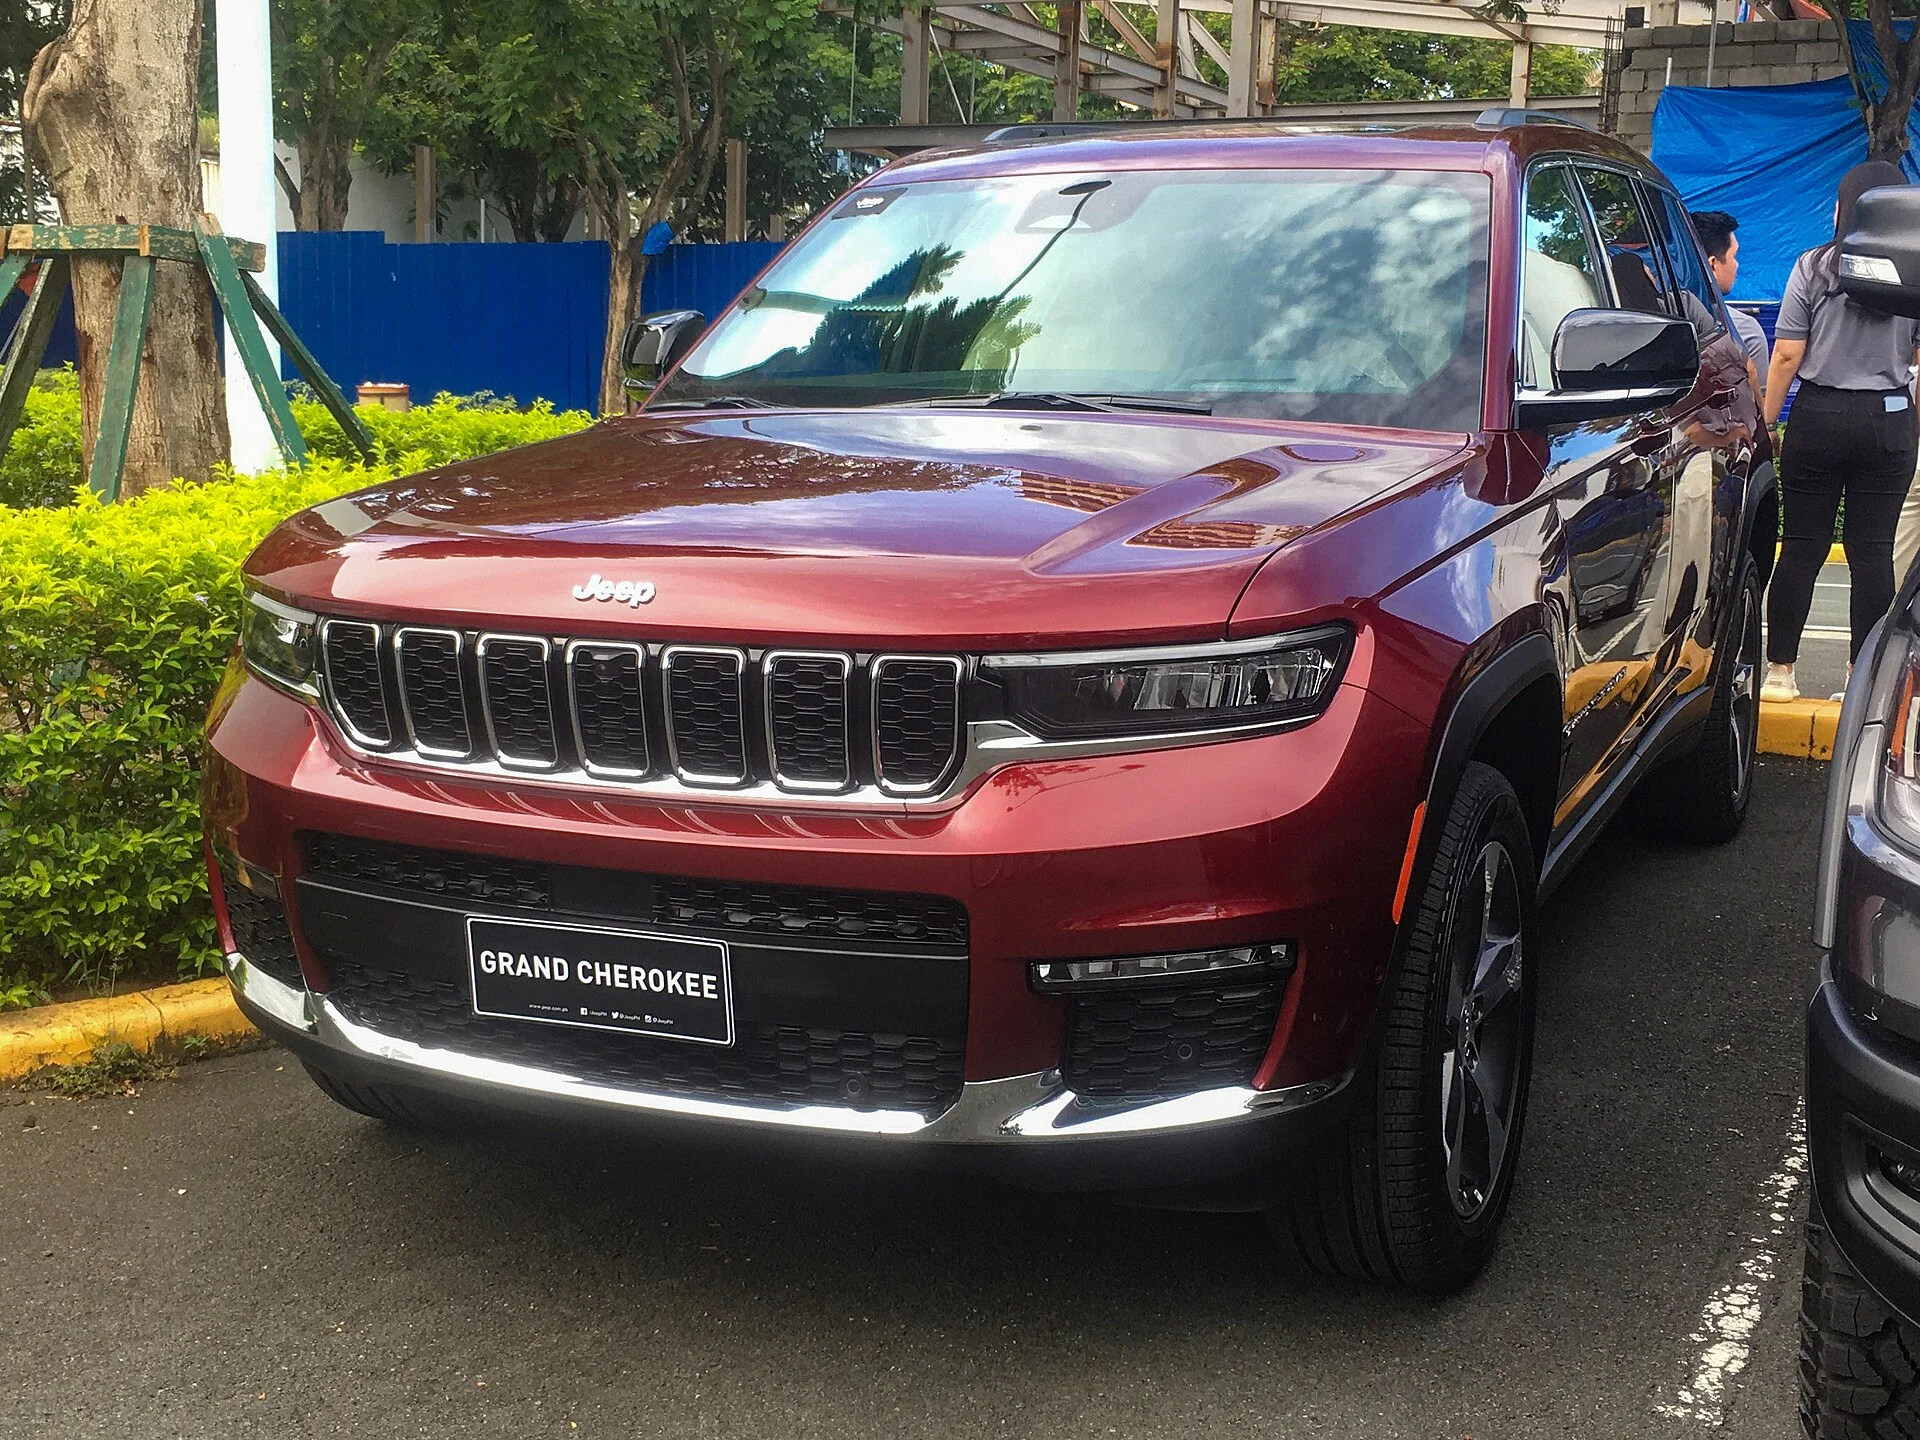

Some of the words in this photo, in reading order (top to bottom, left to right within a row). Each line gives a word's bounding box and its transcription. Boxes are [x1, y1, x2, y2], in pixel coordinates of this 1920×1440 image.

[572, 573, 656, 608] Jeep
[480, 950, 570, 982] GRAND
[576, 959, 719, 999] CHEROKEE
